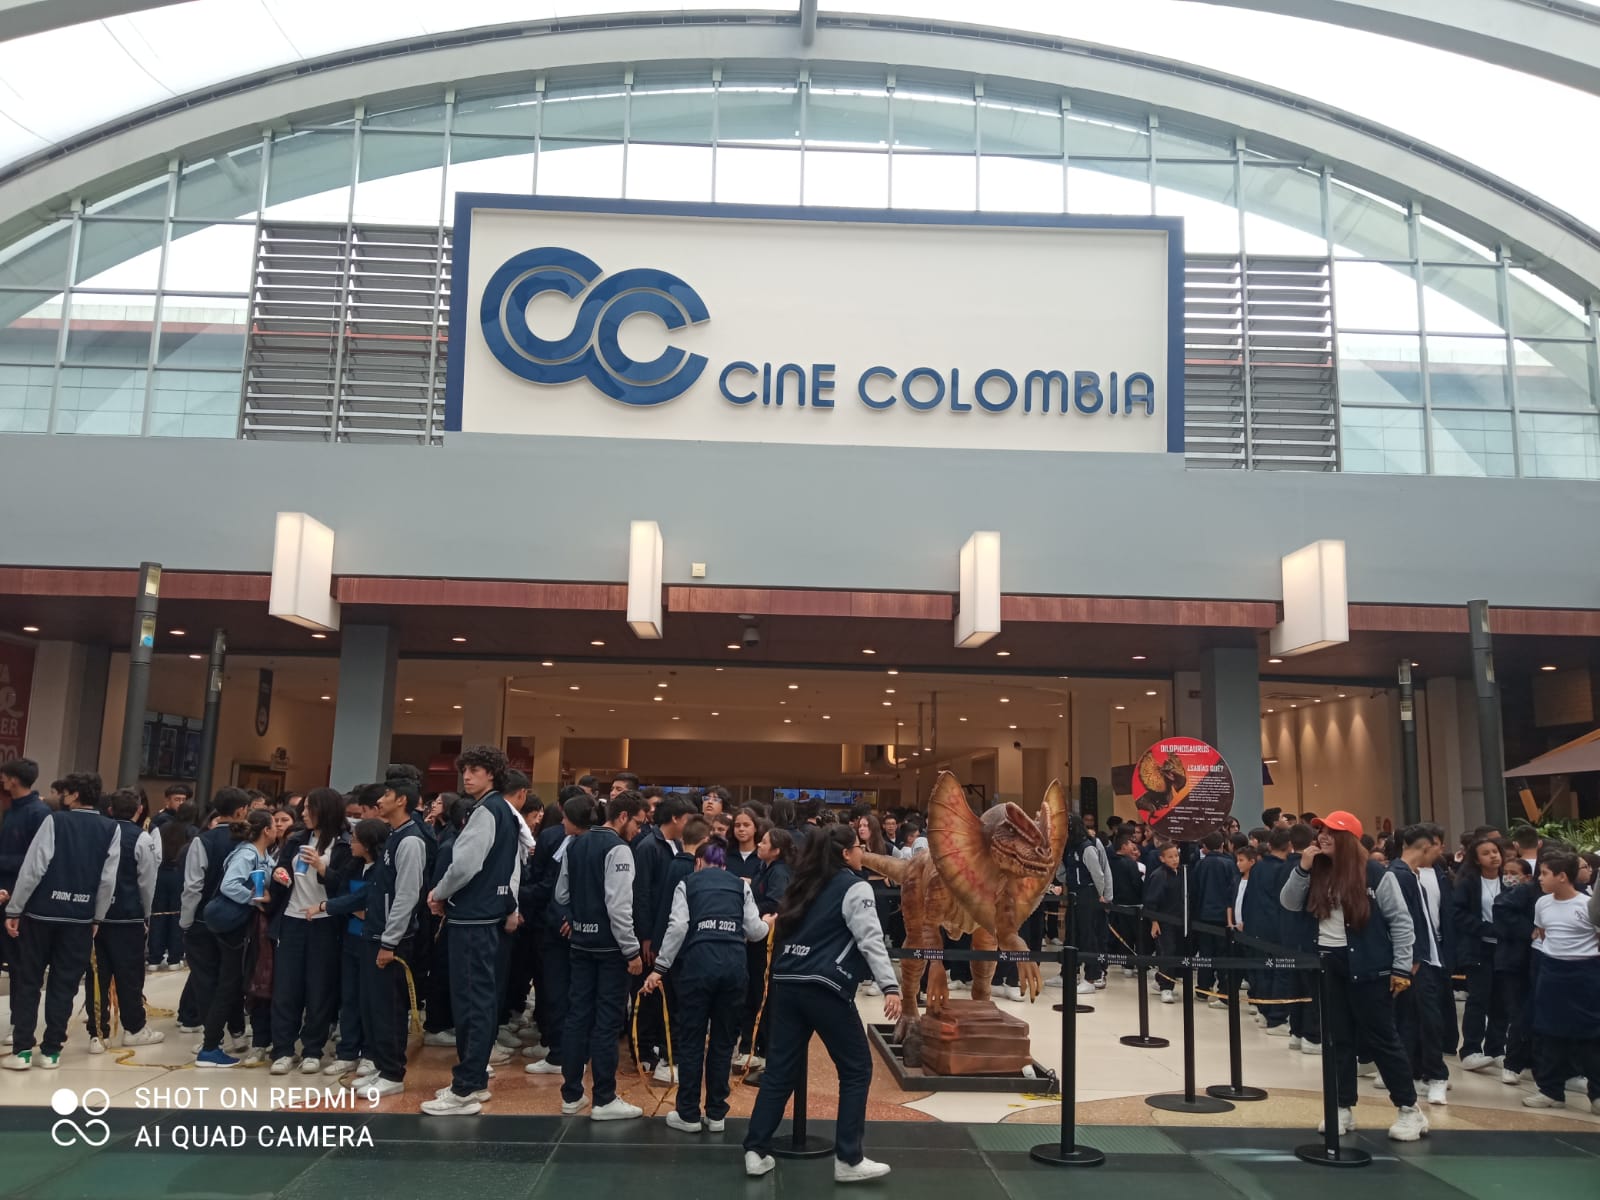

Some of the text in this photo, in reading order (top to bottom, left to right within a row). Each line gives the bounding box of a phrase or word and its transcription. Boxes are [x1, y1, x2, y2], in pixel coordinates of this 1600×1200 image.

[719, 361, 1155, 415] CINE COLOMBIA
[51, 890, 91, 903] PROM 2023
[582, 923, 599, 933] 2023
[697, 919, 737, 932] PROM 2023
